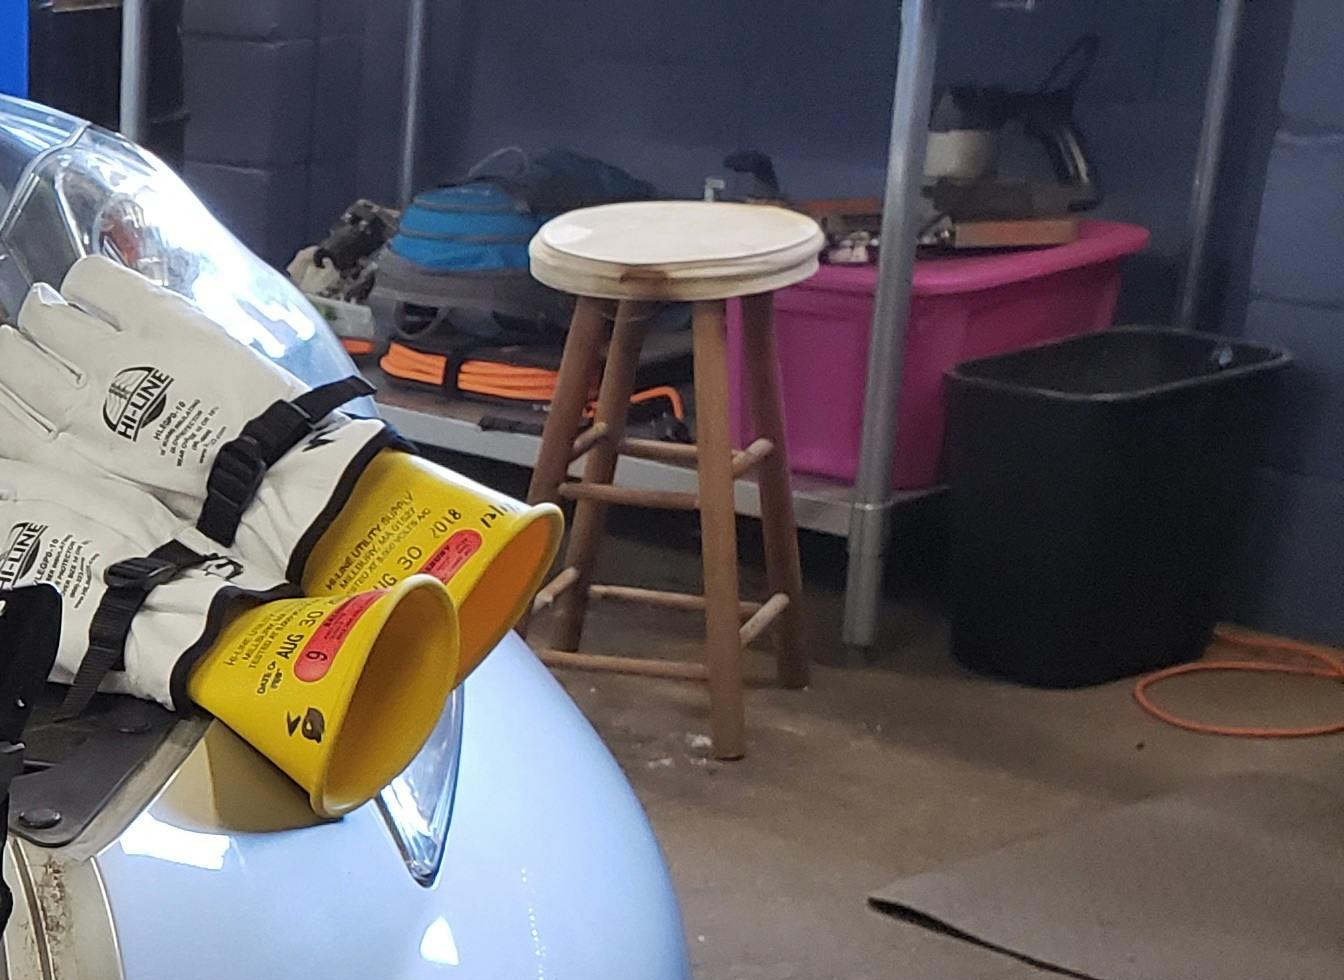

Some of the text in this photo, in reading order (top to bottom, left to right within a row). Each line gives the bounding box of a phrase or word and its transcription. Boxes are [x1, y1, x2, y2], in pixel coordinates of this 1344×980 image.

[117, 369, 169, 440] HI-LINE
[351, 523, 382, 558] UTILITY
[380, 490, 412, 526] SUPPLY
[397, 546, 423, 571] 30
[277, 633, 304, 660] AUG
[299, 610, 325, 628] 30
